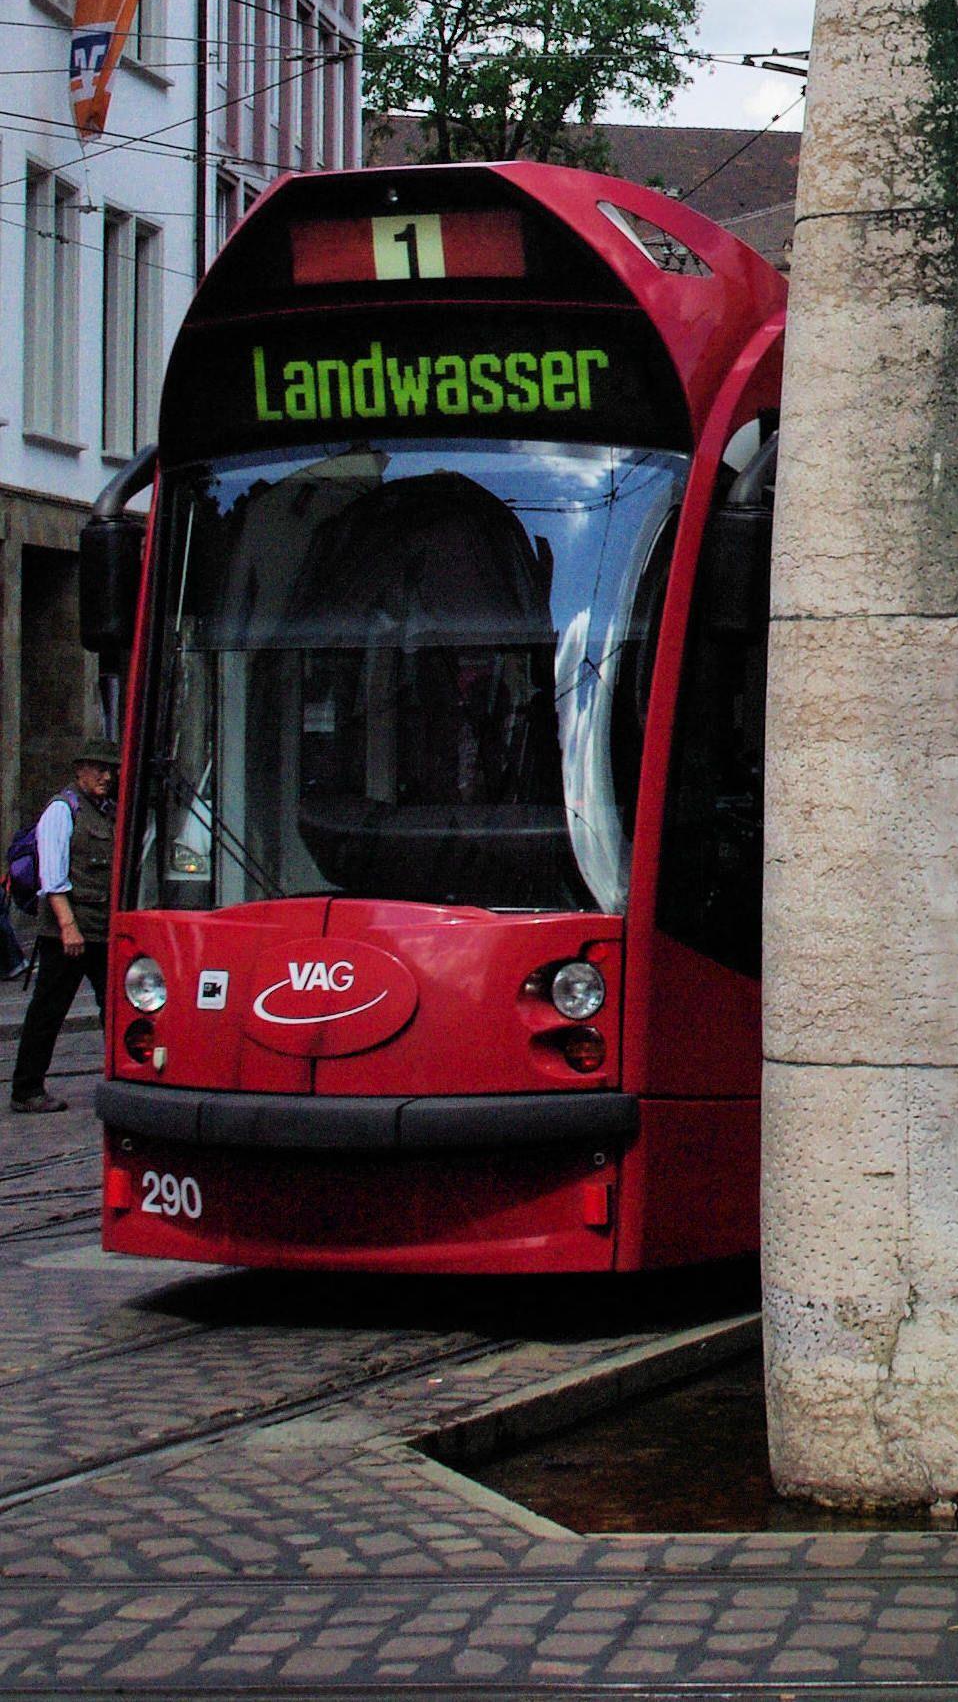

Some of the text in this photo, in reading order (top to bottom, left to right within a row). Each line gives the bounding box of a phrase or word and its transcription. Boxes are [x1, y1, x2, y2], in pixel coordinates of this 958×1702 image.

[394, 223, 420, 279] 1
[253, 341, 610, 422] Landwasser
[288, 961, 355, 991] VAG
[141, 1170, 202, 1218] 290
